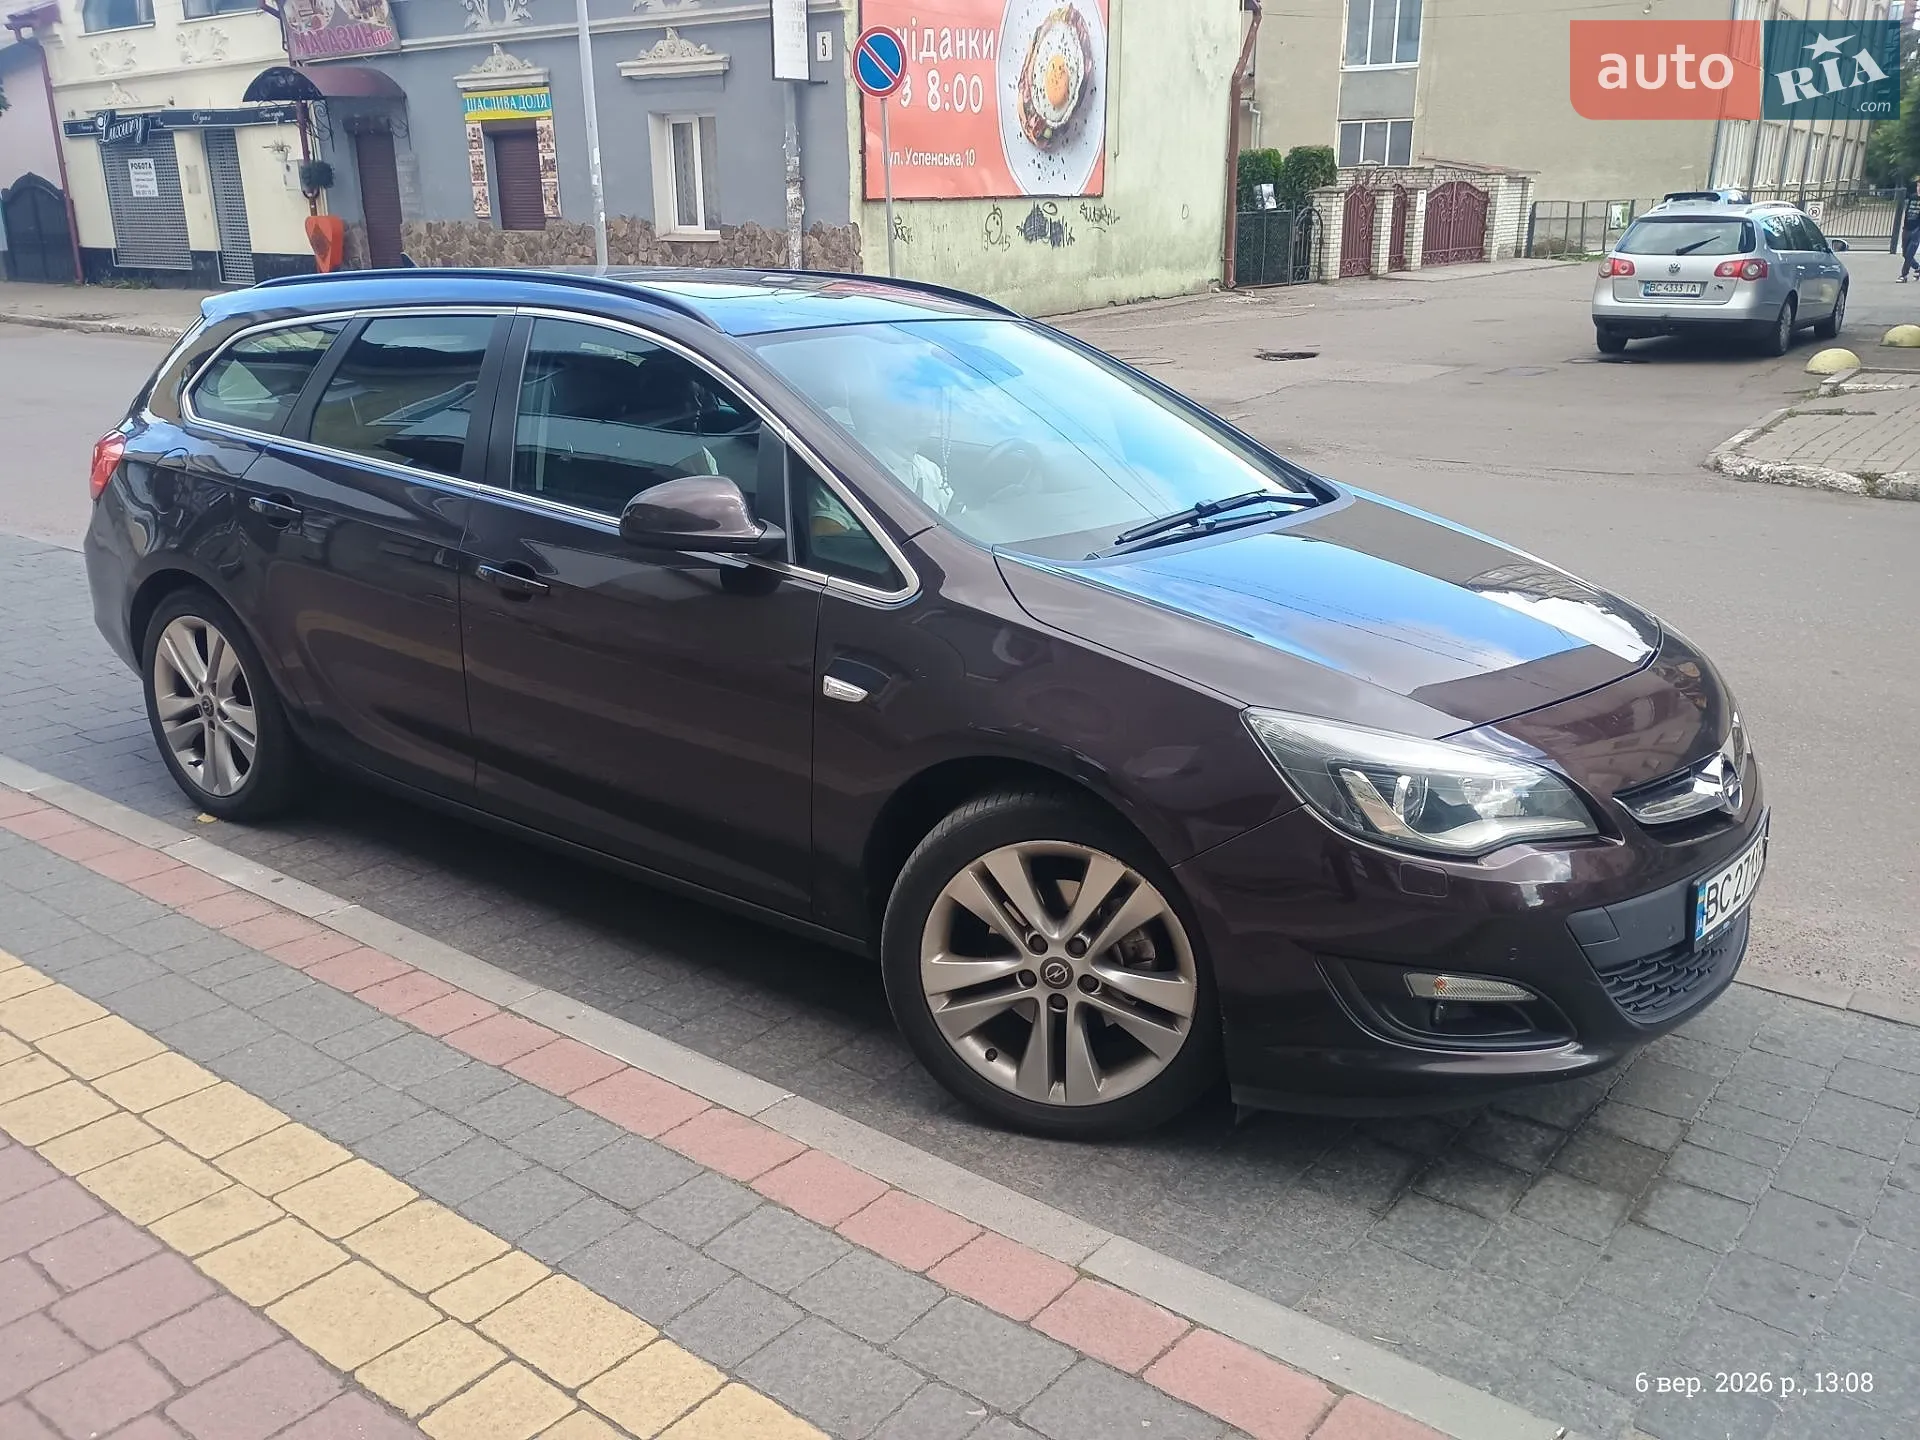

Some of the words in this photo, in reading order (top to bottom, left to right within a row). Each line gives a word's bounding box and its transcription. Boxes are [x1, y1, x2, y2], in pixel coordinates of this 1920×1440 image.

[821, 36, 828, 57] 5
[894, 16, 995, 65] ніданки
[519, 93, 548, 110] ДОЛЯ
[927, 69, 983, 114] 8:00
[100, 111, 142, 144] Luxury
[905, 146, 964, 169] Успенська,
[965, 148, 976, 167] 10
[1649, 283, 1663, 292] BC
[1663, 283, 1683, 293] 4333
[1705, 873, 1732, 926] BC
